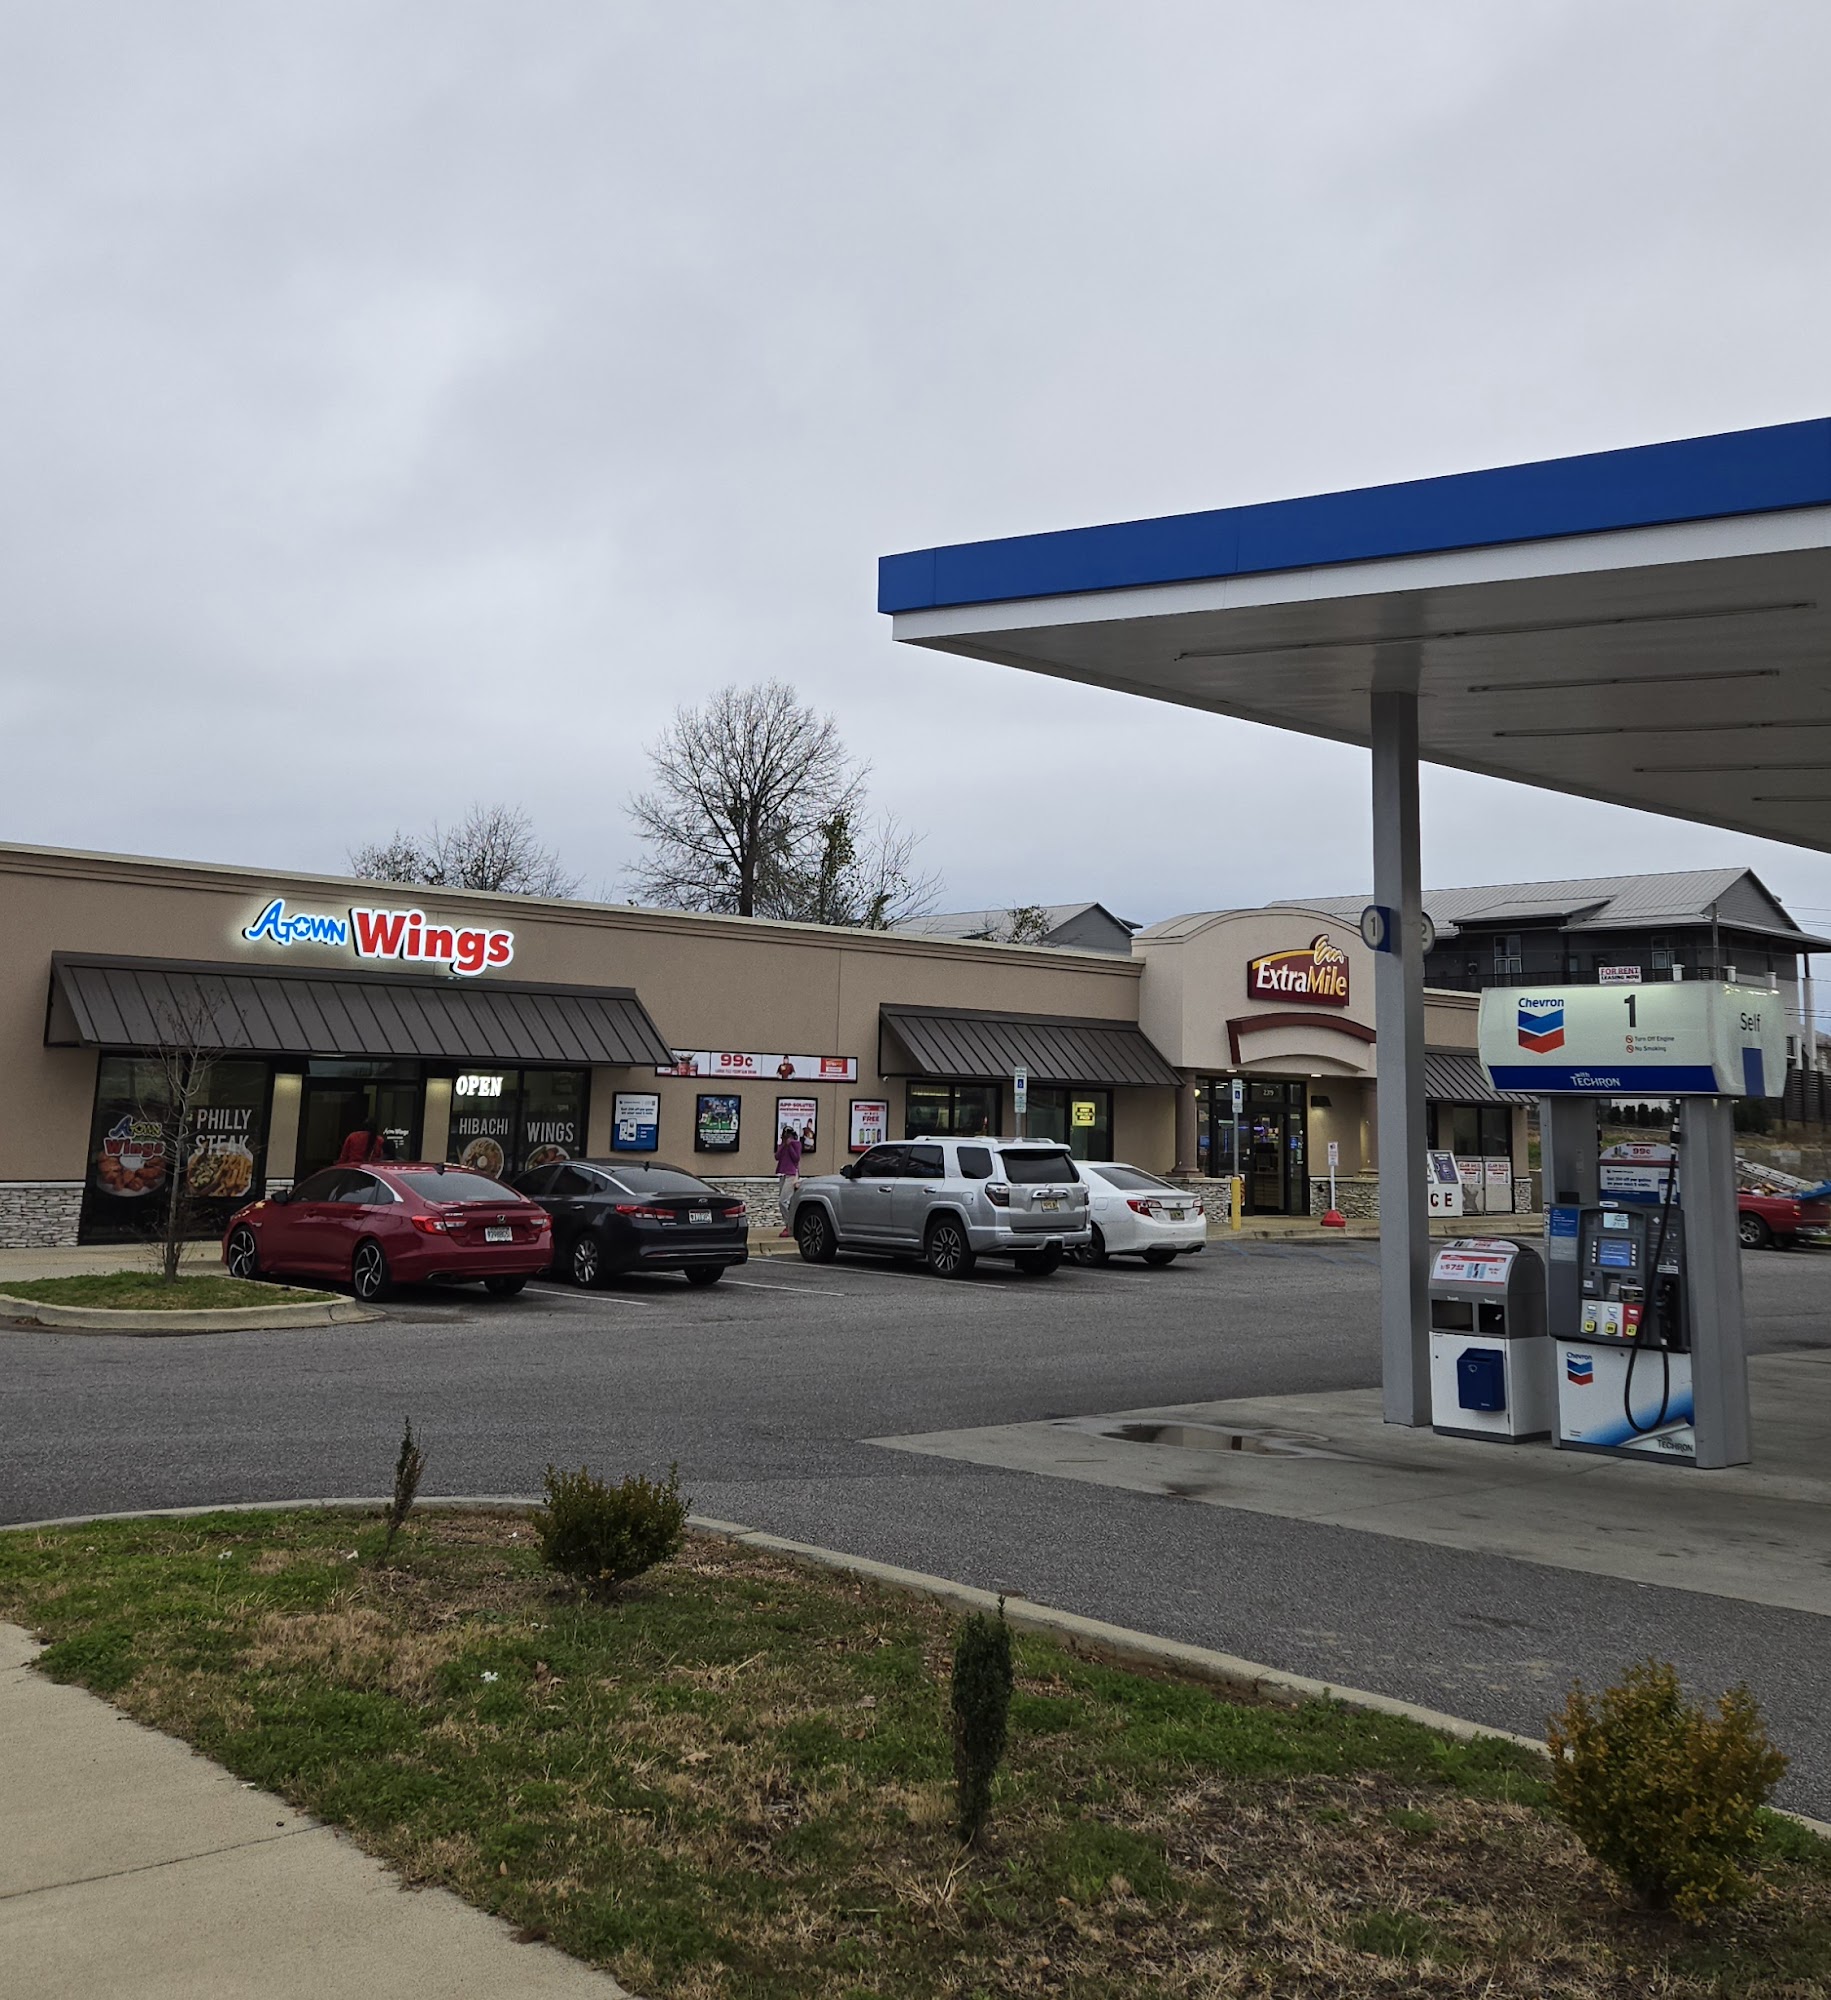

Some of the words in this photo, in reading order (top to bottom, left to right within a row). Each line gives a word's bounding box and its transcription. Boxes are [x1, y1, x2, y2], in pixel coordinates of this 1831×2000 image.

[1370, 916, 1376, 937] 1
[355, 911, 511, 972] Wings
[1256, 961, 1347, 996] ExtraMile
[1518, 998, 1565, 1008] Chevron
[1623, 994, 1637, 1028] 1
[1740, 1012, 1761, 1032] Self
[455, 1075, 504, 1097] OPEN
[1570, 1076, 1621, 1088] TECHRON
[197, 1108, 252, 1130] PHILLY
[458, 1117, 509, 1136] HIBACHI
[526, 1122, 575, 1143] WINGS
[103, 1137, 166, 1160] Wings
[194, 1134, 250, 1156] STEAK
[1566, 1351, 1593, 1361] Chevron
[1657, 1439, 1694, 1452] TECHRON
